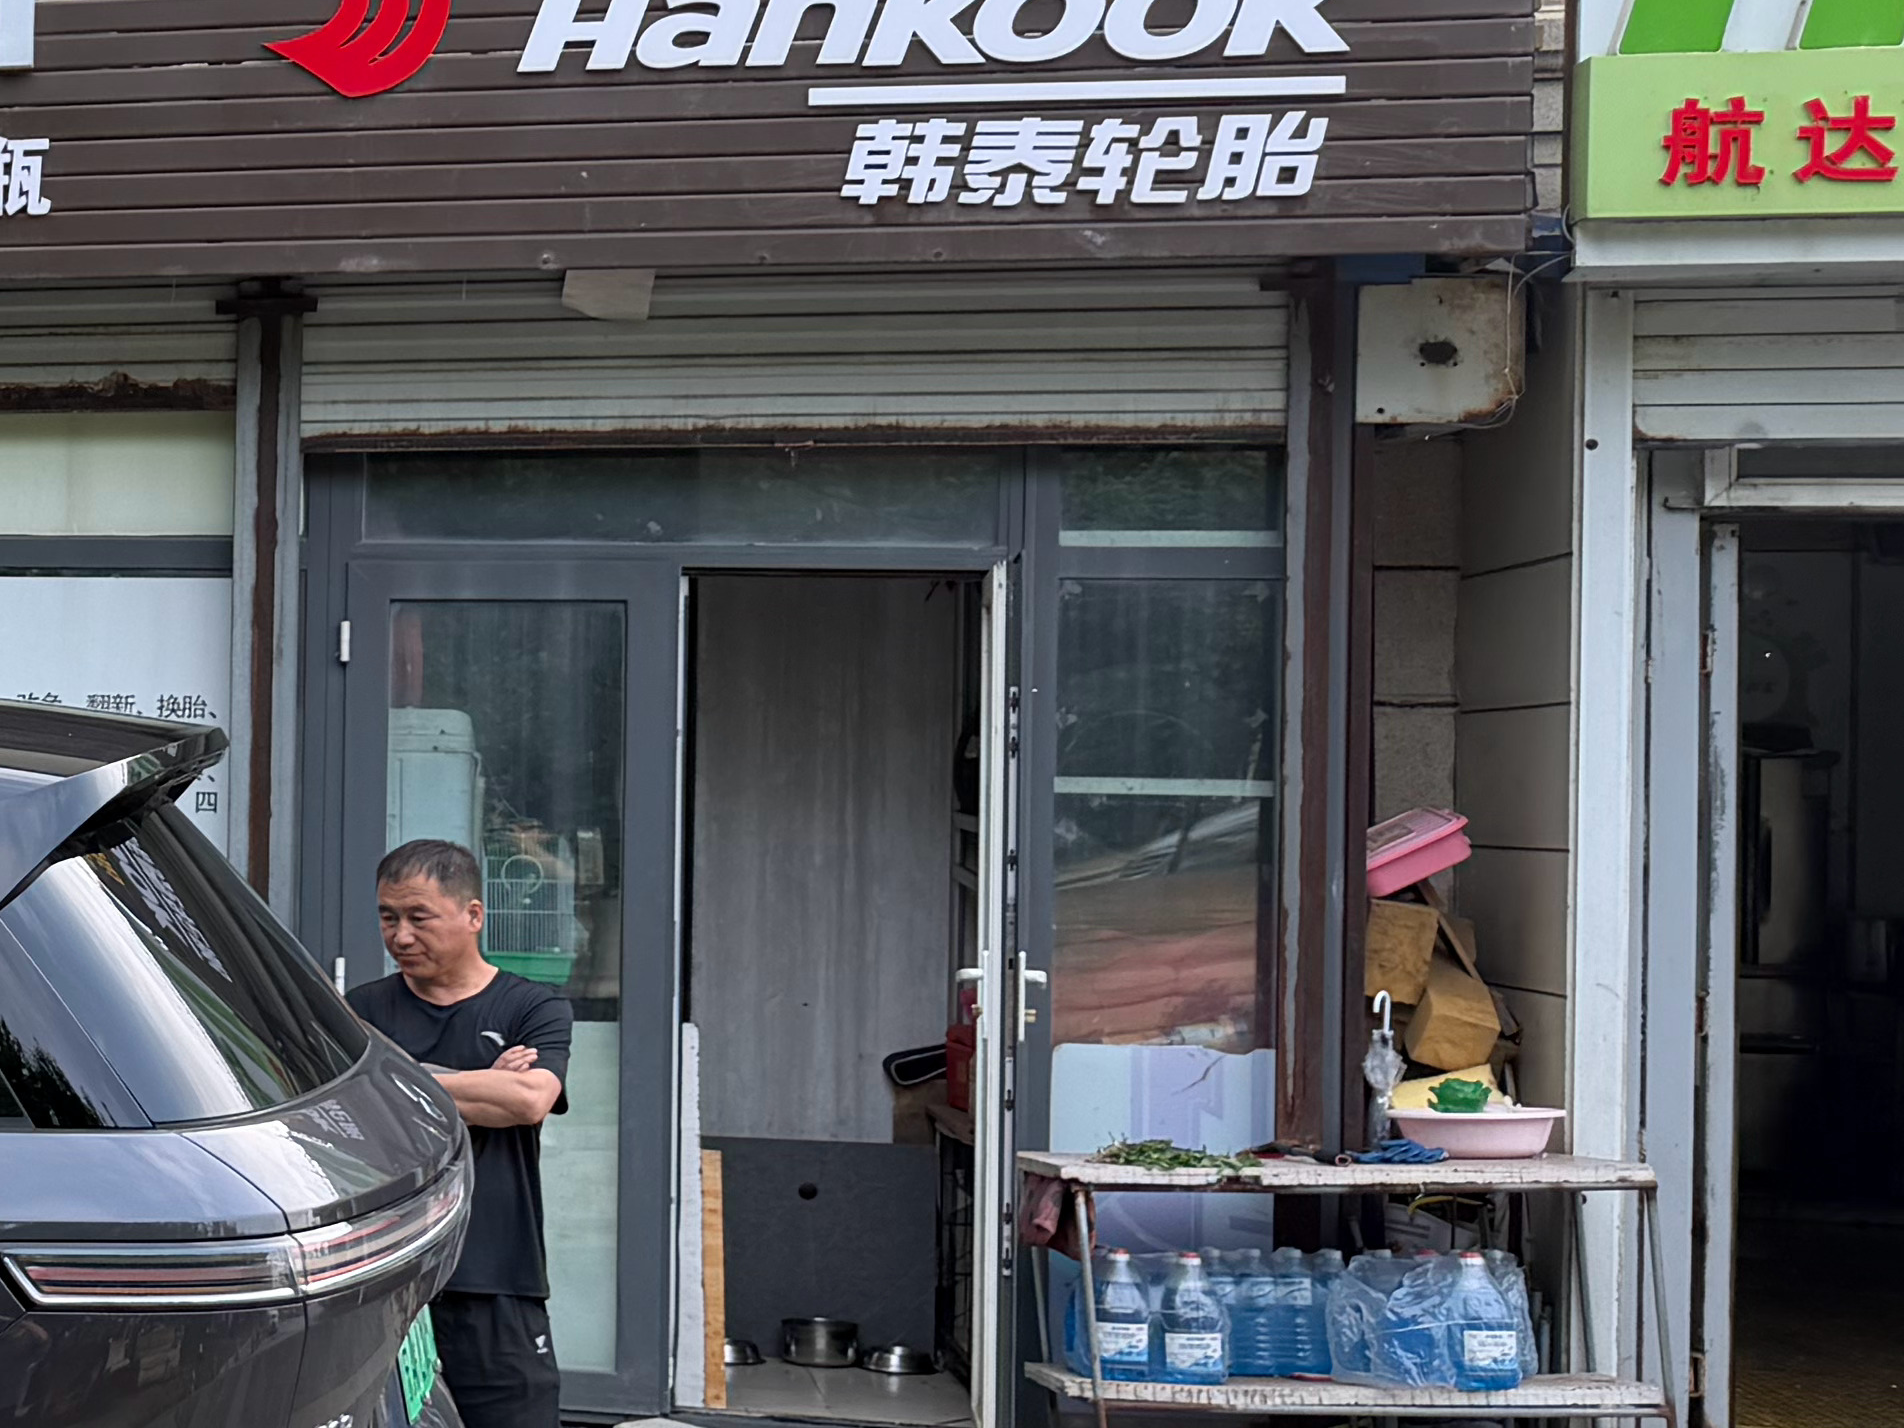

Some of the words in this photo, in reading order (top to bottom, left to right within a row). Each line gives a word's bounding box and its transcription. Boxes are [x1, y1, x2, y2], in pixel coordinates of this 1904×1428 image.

[840, 111, 1329, 207] 韩泰轮胎
[1659, 95, 1899, 187] 航达
